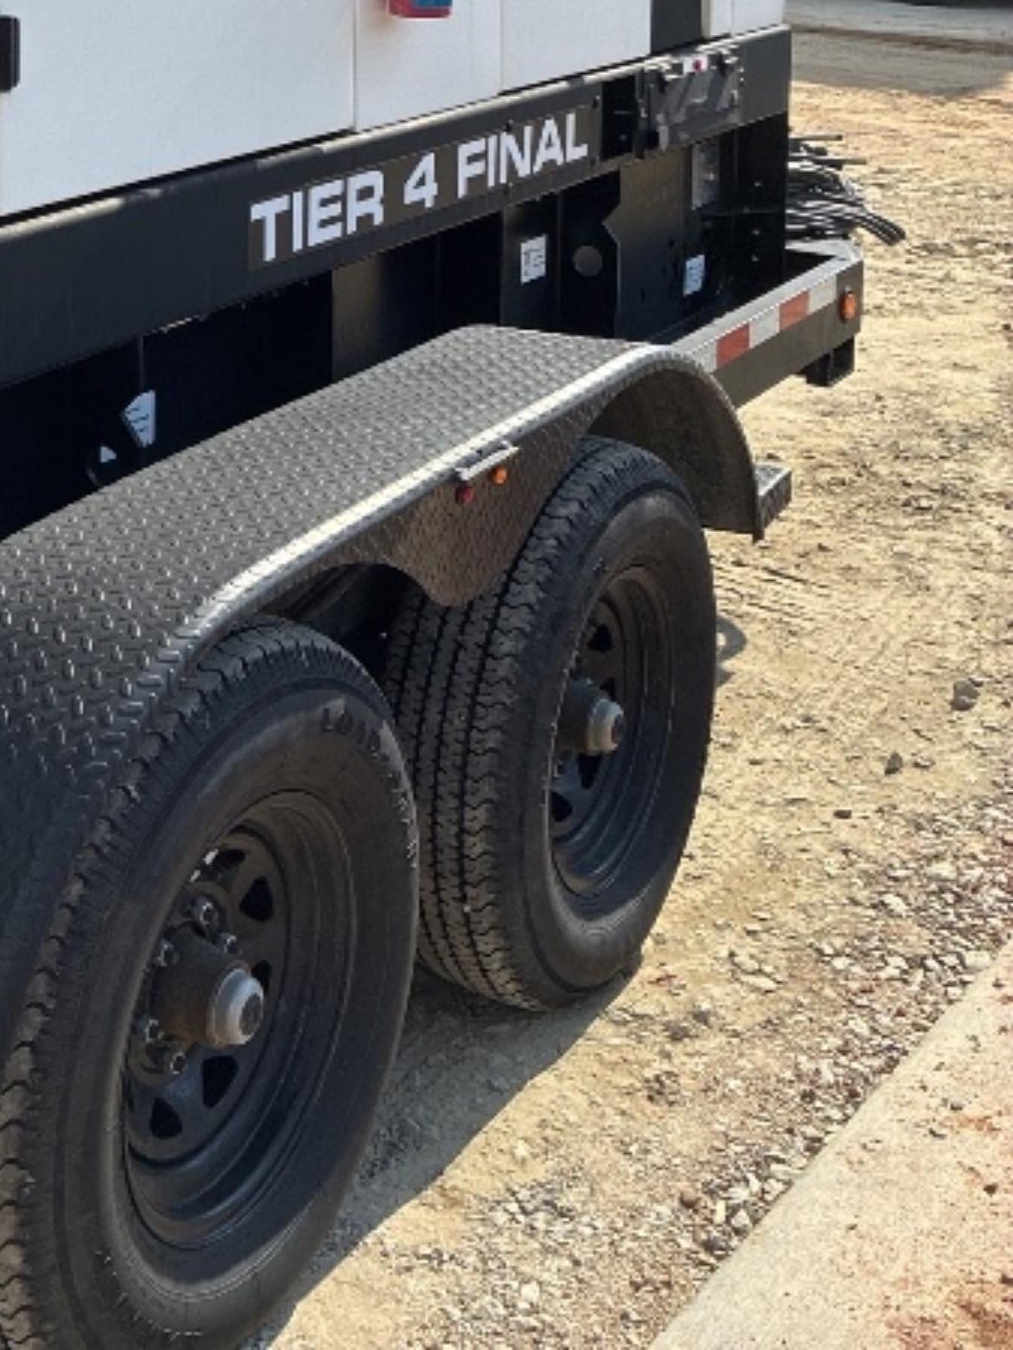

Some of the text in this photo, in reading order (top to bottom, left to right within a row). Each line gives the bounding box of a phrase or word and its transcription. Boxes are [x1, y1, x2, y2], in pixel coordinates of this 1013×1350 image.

[250, 112, 588, 262] TIER 4 FINAL
